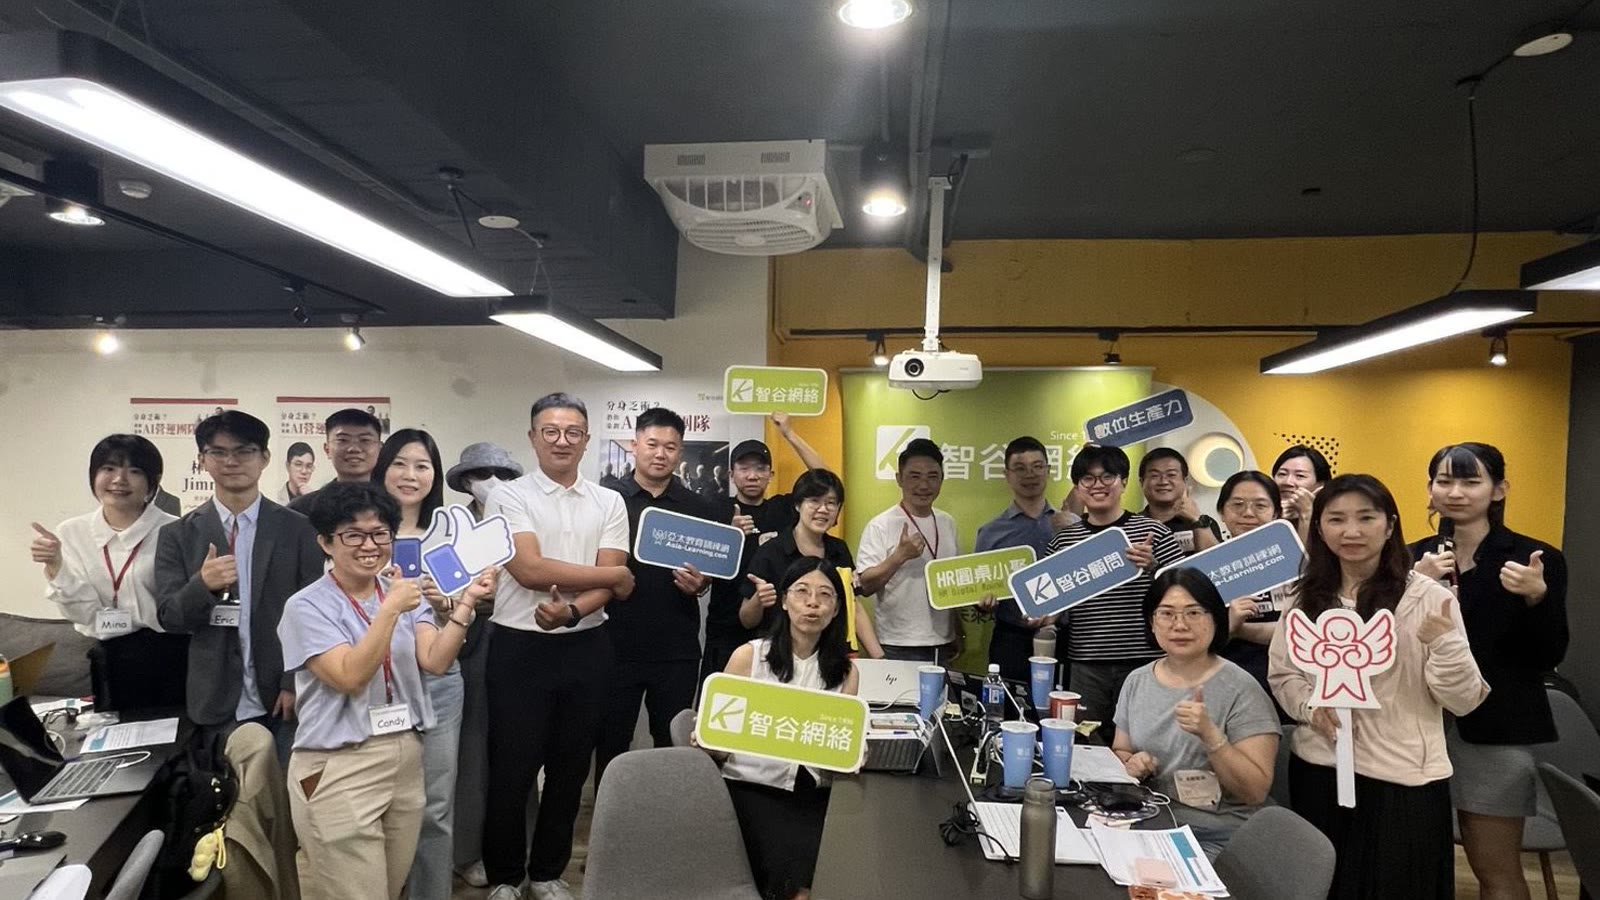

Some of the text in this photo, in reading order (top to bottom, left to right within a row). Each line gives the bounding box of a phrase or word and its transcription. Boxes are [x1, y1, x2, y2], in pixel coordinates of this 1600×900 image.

[755, 386, 819, 404] 智谷網絡
[1094, 399, 1183, 440] 數位生產力
[1050, 430, 1078, 441] Since
[665, 540, 729, 559] Asia-Learning.com
[668, 531, 730, 554] 亞太教育訓練網
[1055, 551, 1125, 593] 智谷顧問
[102, 620, 128, 629] Mina
[215, 615, 235, 625] Eric
[748, 710, 853, 752] 智谷網絡
